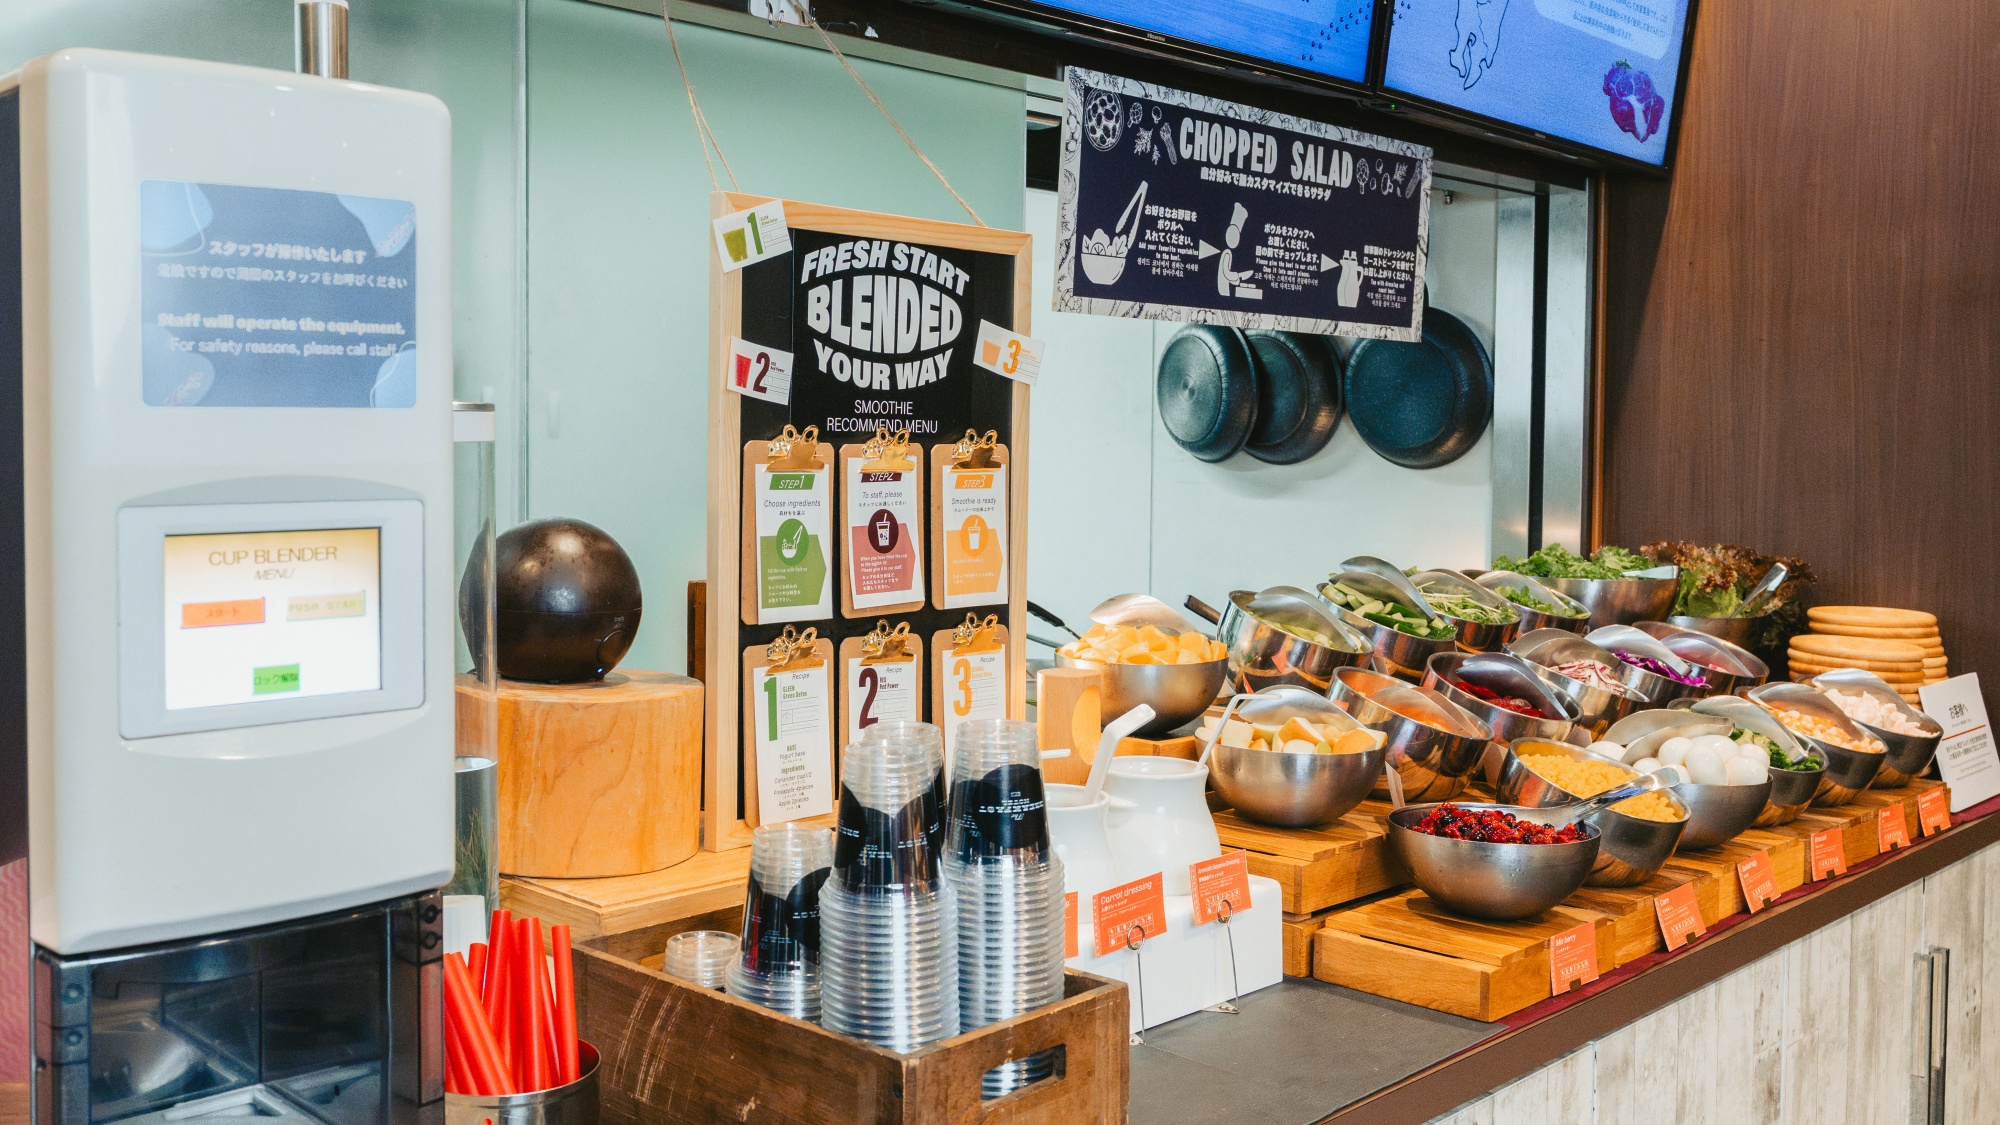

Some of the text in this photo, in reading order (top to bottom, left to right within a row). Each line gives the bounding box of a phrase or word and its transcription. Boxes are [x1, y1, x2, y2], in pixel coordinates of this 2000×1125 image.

[1179, 116, 1354, 189] CHOPPED SALAD
[1145, 204, 1197, 222] お好きなお野菜を
[1157, 219, 1184, 231] ボウルへ
[1264, 223, 1315, 239] ボウルをスタッフへ
[747, 212, 764, 256] 1
[1145, 230, 1193, 246] 入れてください。
[1268, 236, 1309, 251] お渡しください。
[1255, 245, 1319, 264] 目の前でチョップします。
[801, 240, 970, 296] FRESH START
[807, 274, 963, 354] BLENDED
[157, 313, 406, 336] Staff will operate the equipment.
[170, 337, 197, 351] For
[198, 338, 243, 356] safety
[303, 341, 344, 357] please
[346, 342, 367, 356] call
[1002, 339, 1021, 374] 3
[753, 351, 770, 394] 2
[813, 339, 954, 391] YOUR WAY
[854, 400, 913, 416] SMOOTHIE
[826, 417, 938, 434] RECOMMEND MENU
[862, 490, 903, 500] To staff, please
[951, 498, 974, 506] Smoothie
[982, 497, 997, 507] ready
[764, 499, 821, 510] Choose ingredients
[208, 546, 338, 566] CUP BLENDER
[253, 567, 296, 581] MENU
[980, 656, 995, 664] Recipe
[792, 672, 810, 681] Recipe
[886, 666, 903, 675] Recipe
[783, 691, 796, 700] Green
[953, 658, 972, 717] 3
[858, 667, 879, 730] 2
[763, 677, 778, 742] 1
[779, 752, 794, 761] Yogurt
[795, 750, 806, 758] base
[774, 775, 795, 785] Coriander
[773, 786, 794, 797] Pineapple
[778, 799, 790, 808] Apple
[1010, 813, 1025, 821] The
[1100, 880, 1153, 905] Carrot dressing
[1564, 934, 1577, 944] berry
